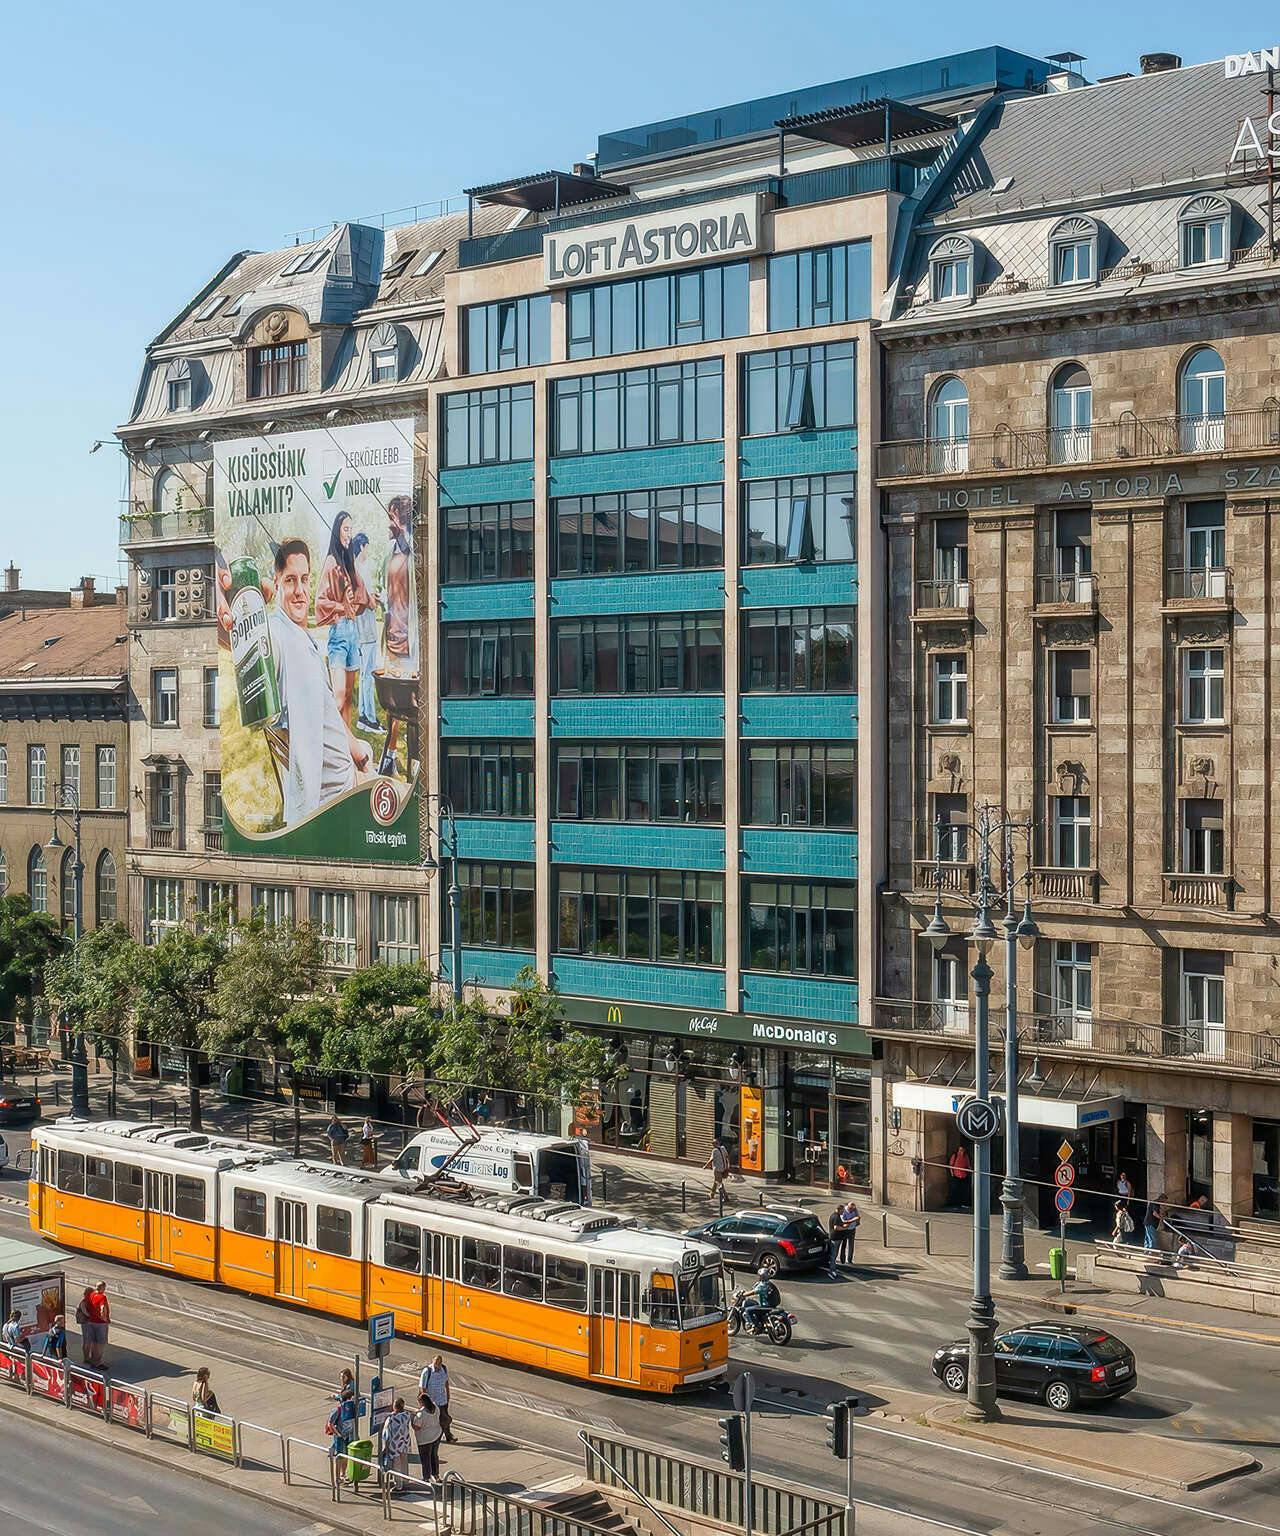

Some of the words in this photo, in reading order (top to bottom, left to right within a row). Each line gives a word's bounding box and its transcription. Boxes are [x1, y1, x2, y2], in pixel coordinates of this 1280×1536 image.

[549, 236, 617, 281] LOFT
[617, 212, 753, 268] ASTORIA
[227, 443, 307, 484] KISÜSSÜNK
[345, 446, 400, 469] LEGKÖZELEBB
[227, 485, 294, 518] VALAMIT?
[345, 477, 382, 498] INDULOK
[936, 485, 1020, 510] HOTEL
[1058, 473, 1184, 500] ASTORIA
[752, 1023, 838, 1046] McDonald's
[683, 1253, 698, 1268] 49
